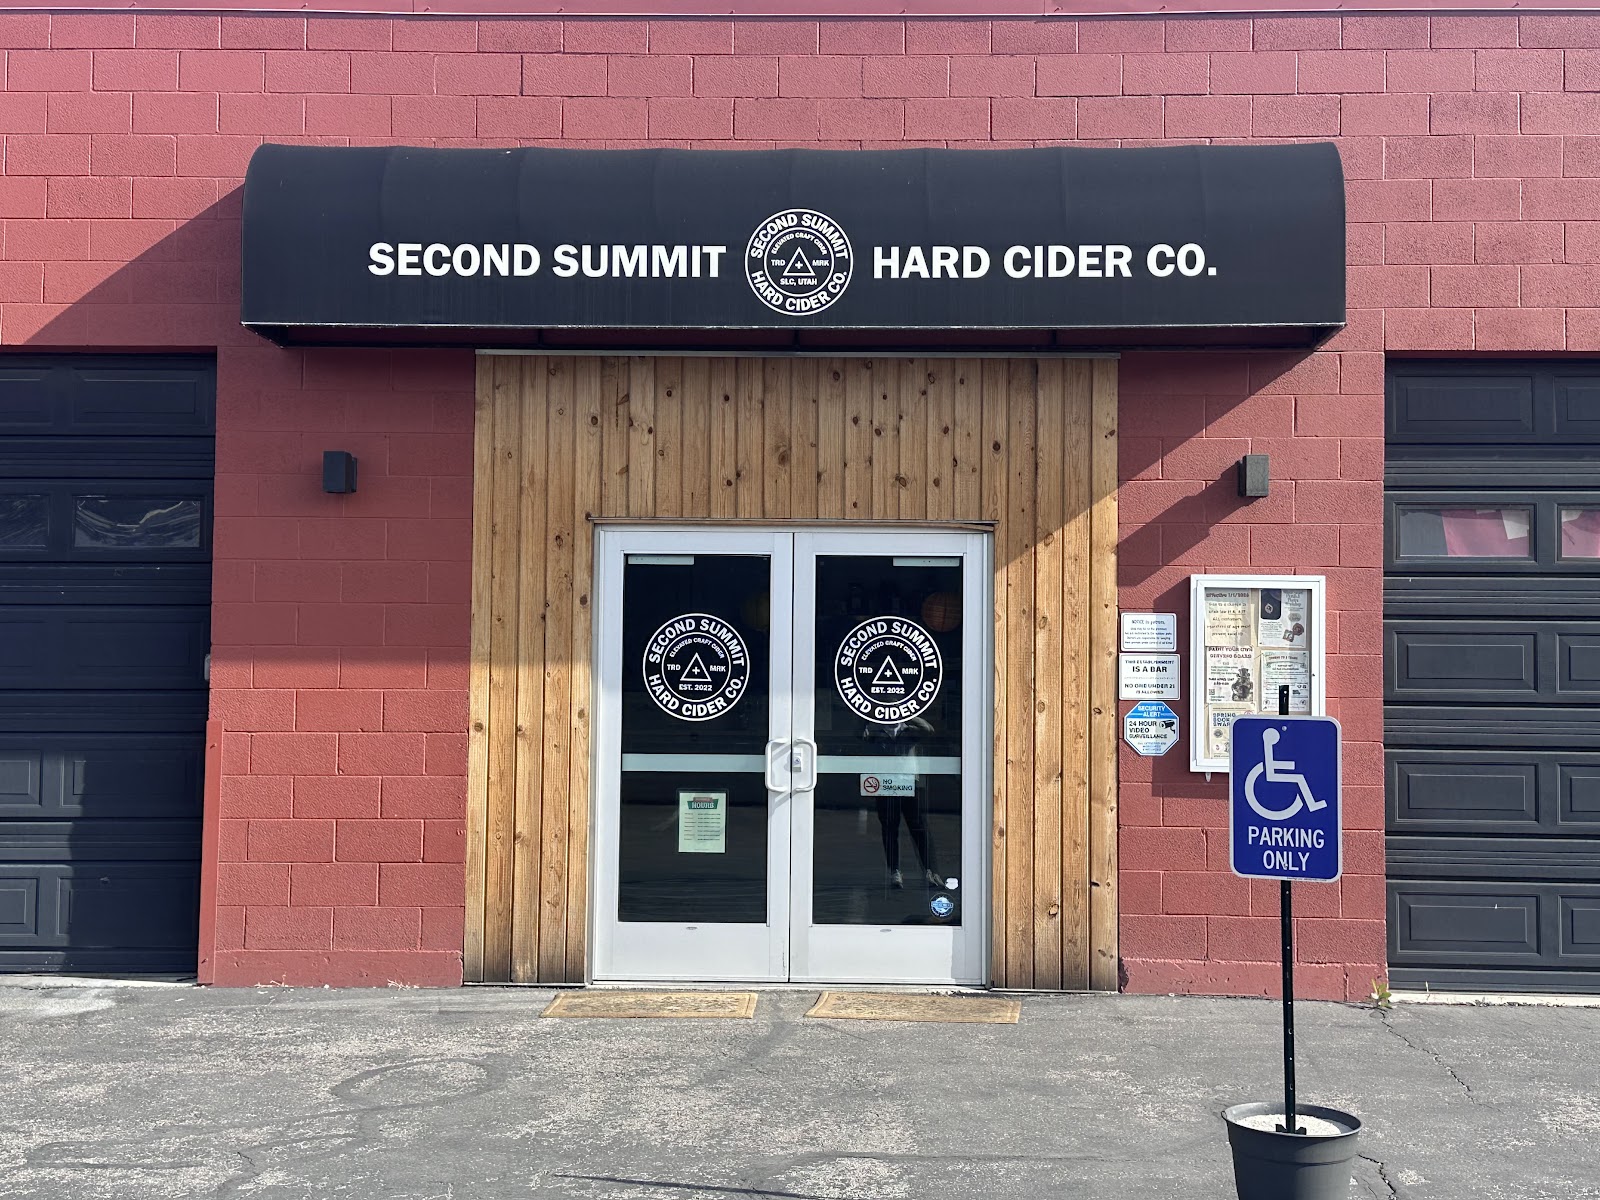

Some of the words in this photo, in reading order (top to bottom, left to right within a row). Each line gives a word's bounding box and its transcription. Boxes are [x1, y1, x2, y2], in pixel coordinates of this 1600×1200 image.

[751, 214, 797, 258] SECOND
[801, 214, 848, 259] SUMMIT
[771, 233, 794, 254] ELEVATED
[795, 232, 815, 241] CRAFT
[368, 243, 540, 278] SECOND
[552, 244, 726, 278] SUMMIT
[873, 246, 990, 278] HARD
[1003, 244, 1132, 278] CIDER
[1146, 243, 1216, 278] CO.
[752, 271, 783, 305] HARD
[786, 291, 831, 311] CIDER
[828, 272, 847, 293] CO.
[649, 619, 696, 663] SECOND
[700, 619, 744, 666] SUMMIT
[670, 639, 692, 658] ELEVATED
[841, 622, 887, 666] SECOND
[891, 622, 937, 668] SUMMIT
[862, 642, 884, 660] ELEVATED
[649, 674, 679, 710] HARD
[682, 697, 727, 716] CIDER
[725, 676, 744, 698] CO.
[841, 677, 871, 713] HARD
[875, 700, 920, 719] CIDER
[918, 679, 937, 701] CO.
[1248, 826, 1324, 848] PARKING
[1263, 851, 1310, 871] ONLY
